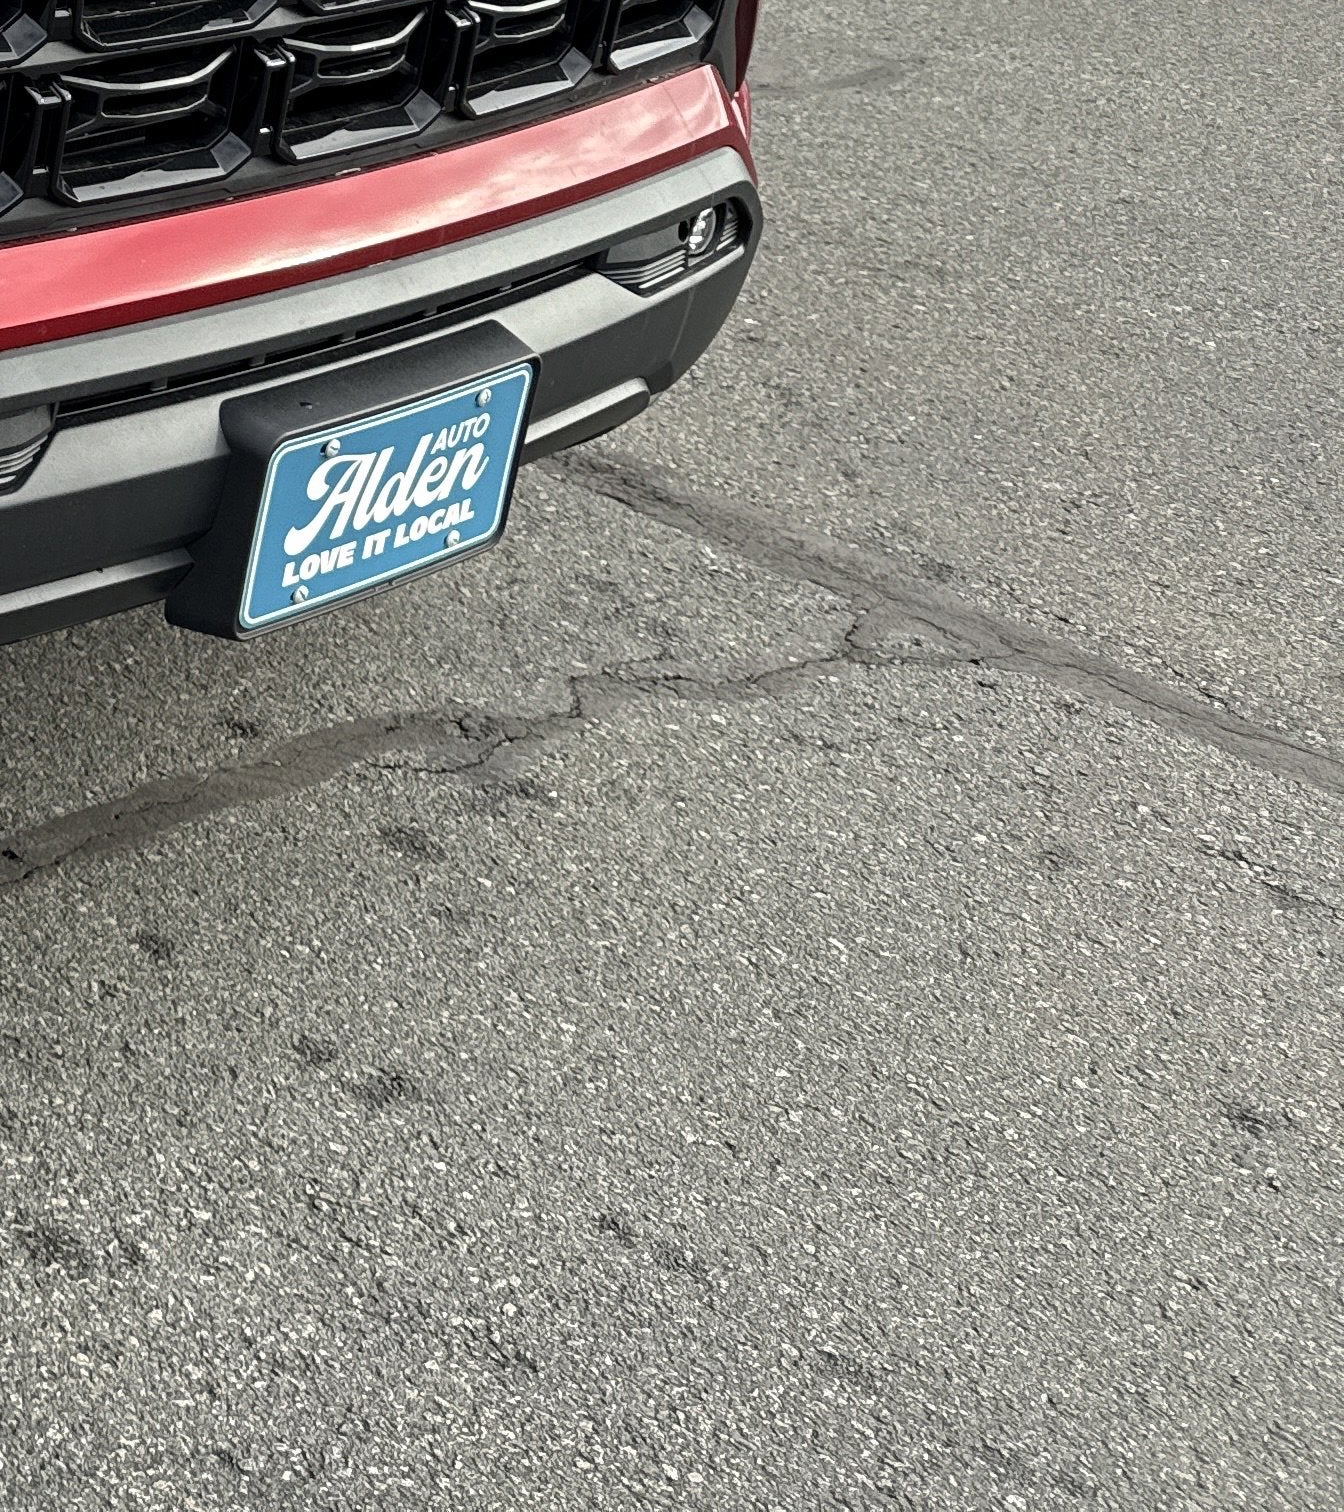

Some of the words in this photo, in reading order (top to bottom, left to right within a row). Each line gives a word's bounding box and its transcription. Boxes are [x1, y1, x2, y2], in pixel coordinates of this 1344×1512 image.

[430, 412, 491, 455] AUTO
[283, 432, 491, 556] Alden
[281, 540, 358, 588] LOVE
[361, 528, 392, 560] IT
[393, 497, 475, 549] LOCAL
